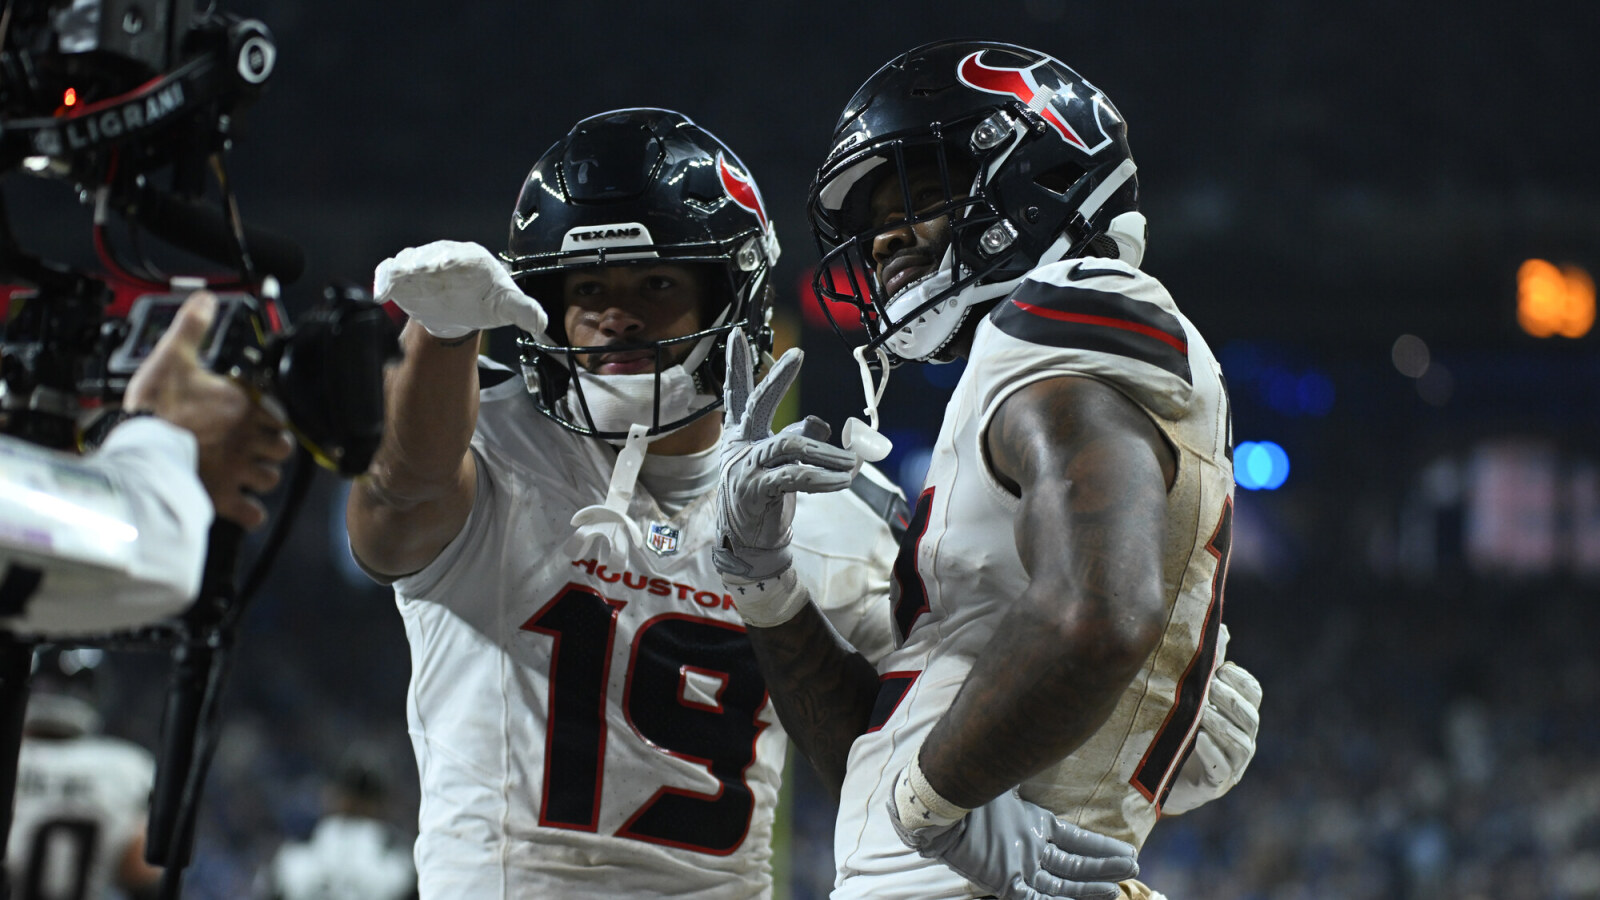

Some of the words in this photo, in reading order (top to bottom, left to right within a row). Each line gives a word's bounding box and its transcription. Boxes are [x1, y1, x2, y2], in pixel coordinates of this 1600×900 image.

[570, 228, 641, 242] TEXANS
[652, 533, 675, 550] NFL
[520, 582, 771, 856] 19
